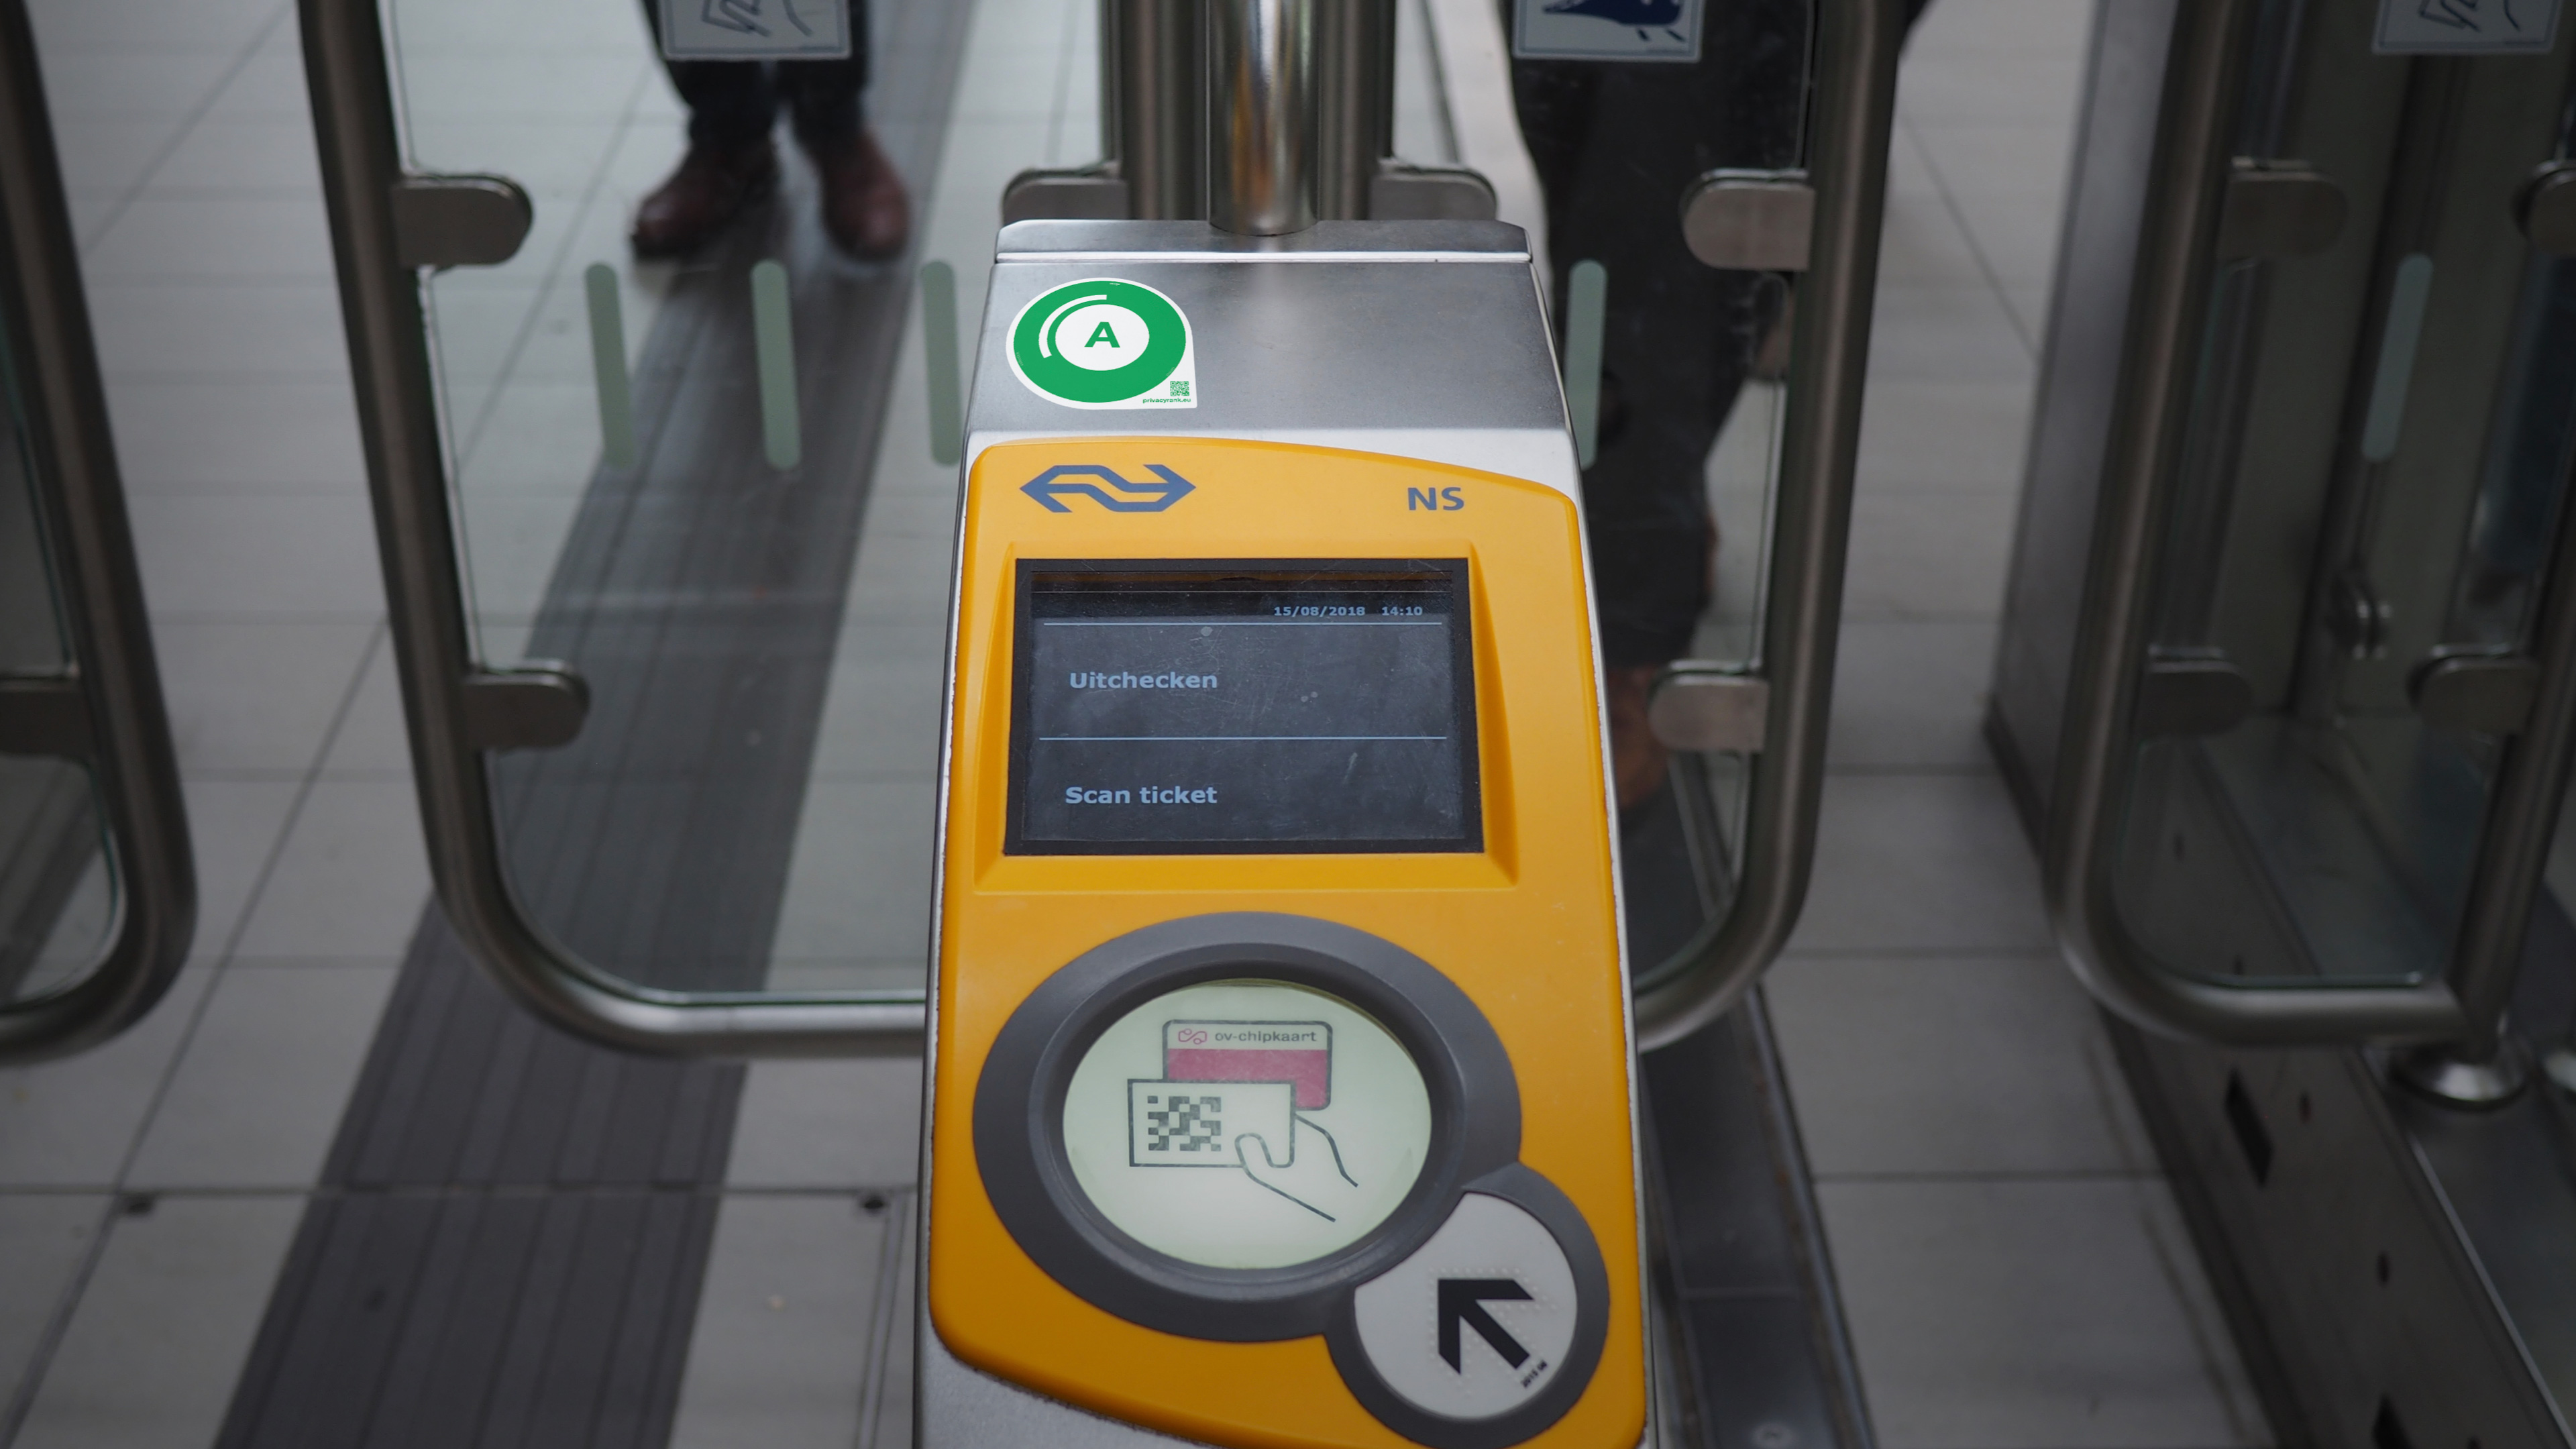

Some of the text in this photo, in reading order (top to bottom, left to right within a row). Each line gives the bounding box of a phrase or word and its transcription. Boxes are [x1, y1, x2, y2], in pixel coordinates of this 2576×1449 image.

[1084, 321, 1120, 347] A
[1407, 486, 1464, 511] NS
[1274, 606, 1423, 617] 15/08/2018 14:10
[1069, 672, 1218, 689] Uitchecken
[1065, 786, 1218, 804] Scan ticket
[1215, 1031, 1318, 1043] ov-chipkaart
